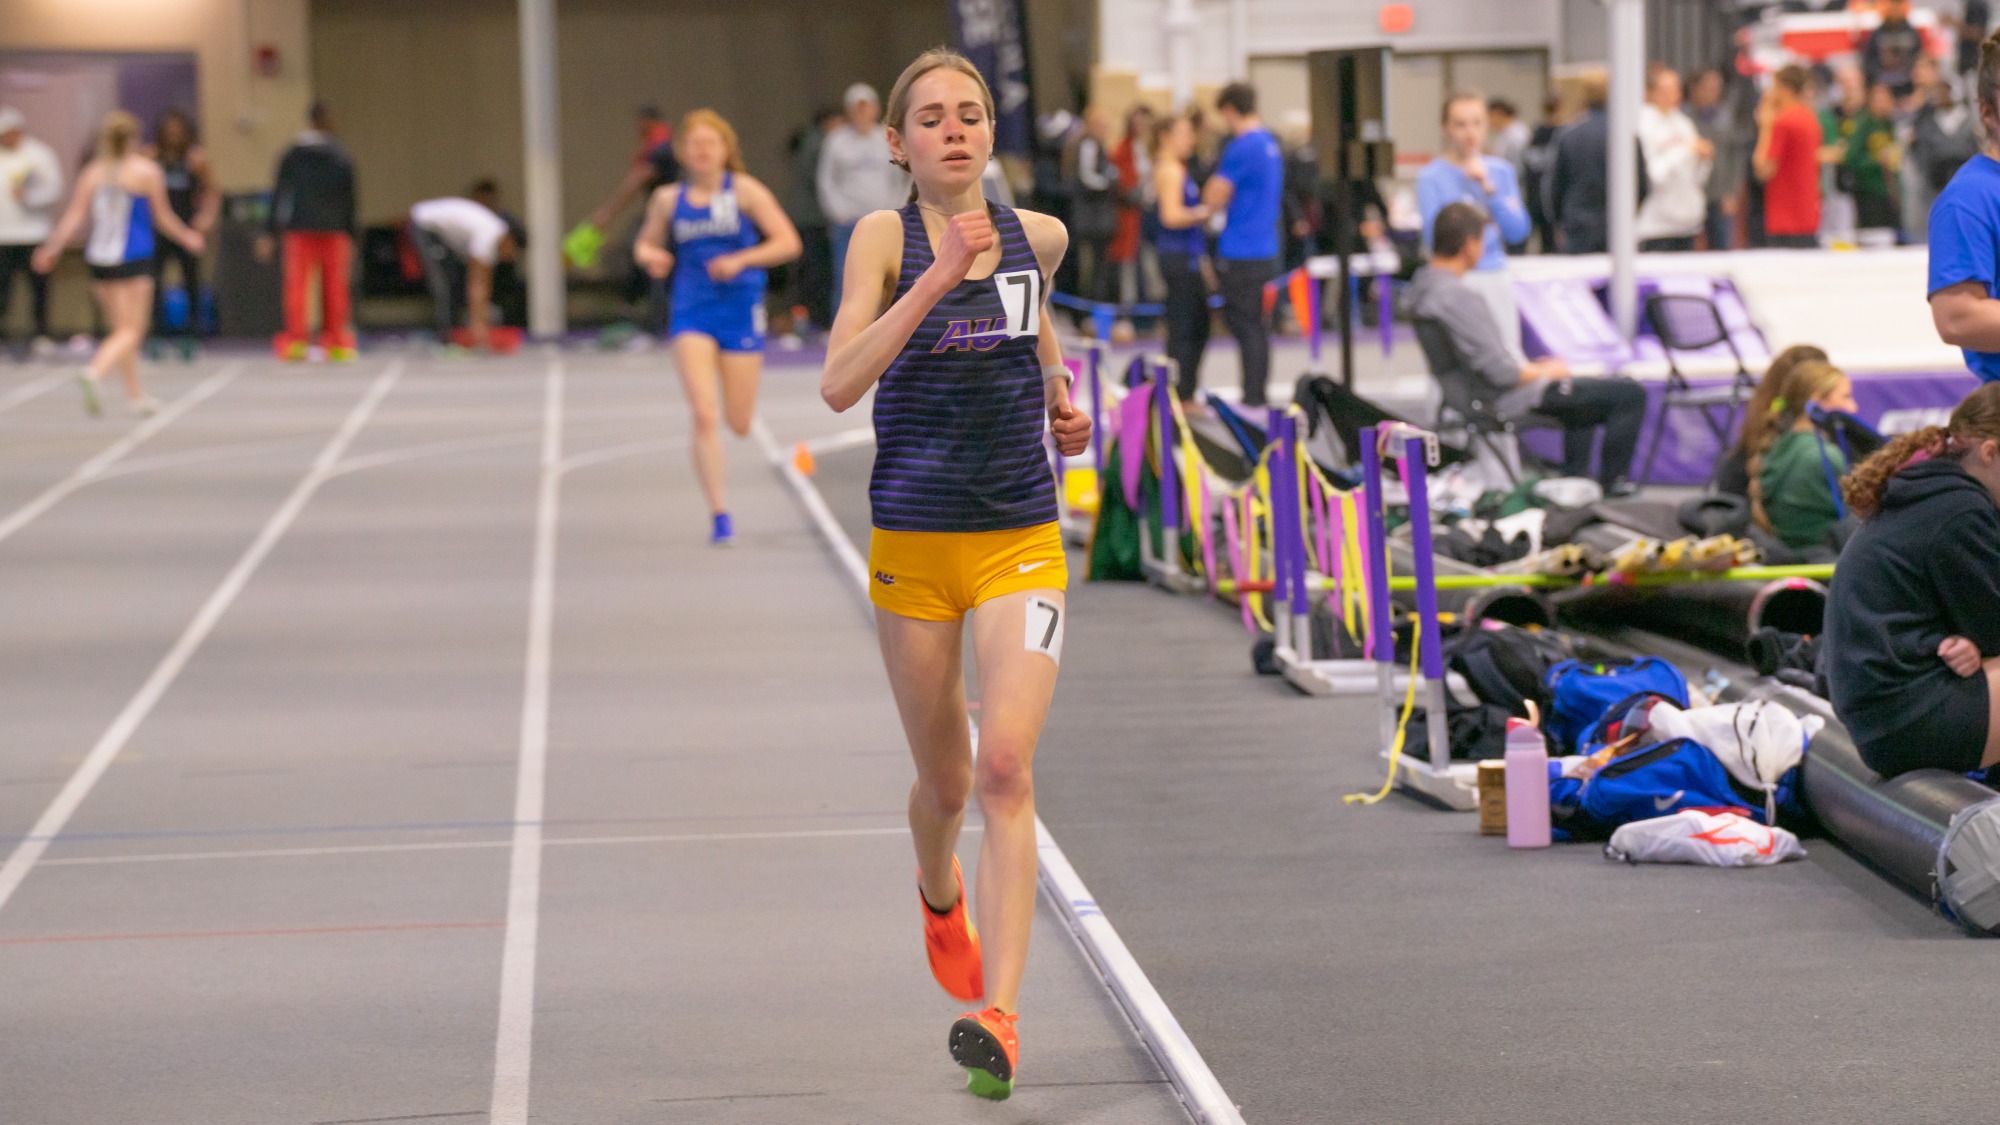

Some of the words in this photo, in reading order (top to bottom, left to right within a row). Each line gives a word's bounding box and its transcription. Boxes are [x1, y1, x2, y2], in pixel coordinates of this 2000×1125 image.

[1005, 274, 1032, 332] 7
[930, 316, 1010, 353] AU
[1037, 601, 1059, 650] 7
